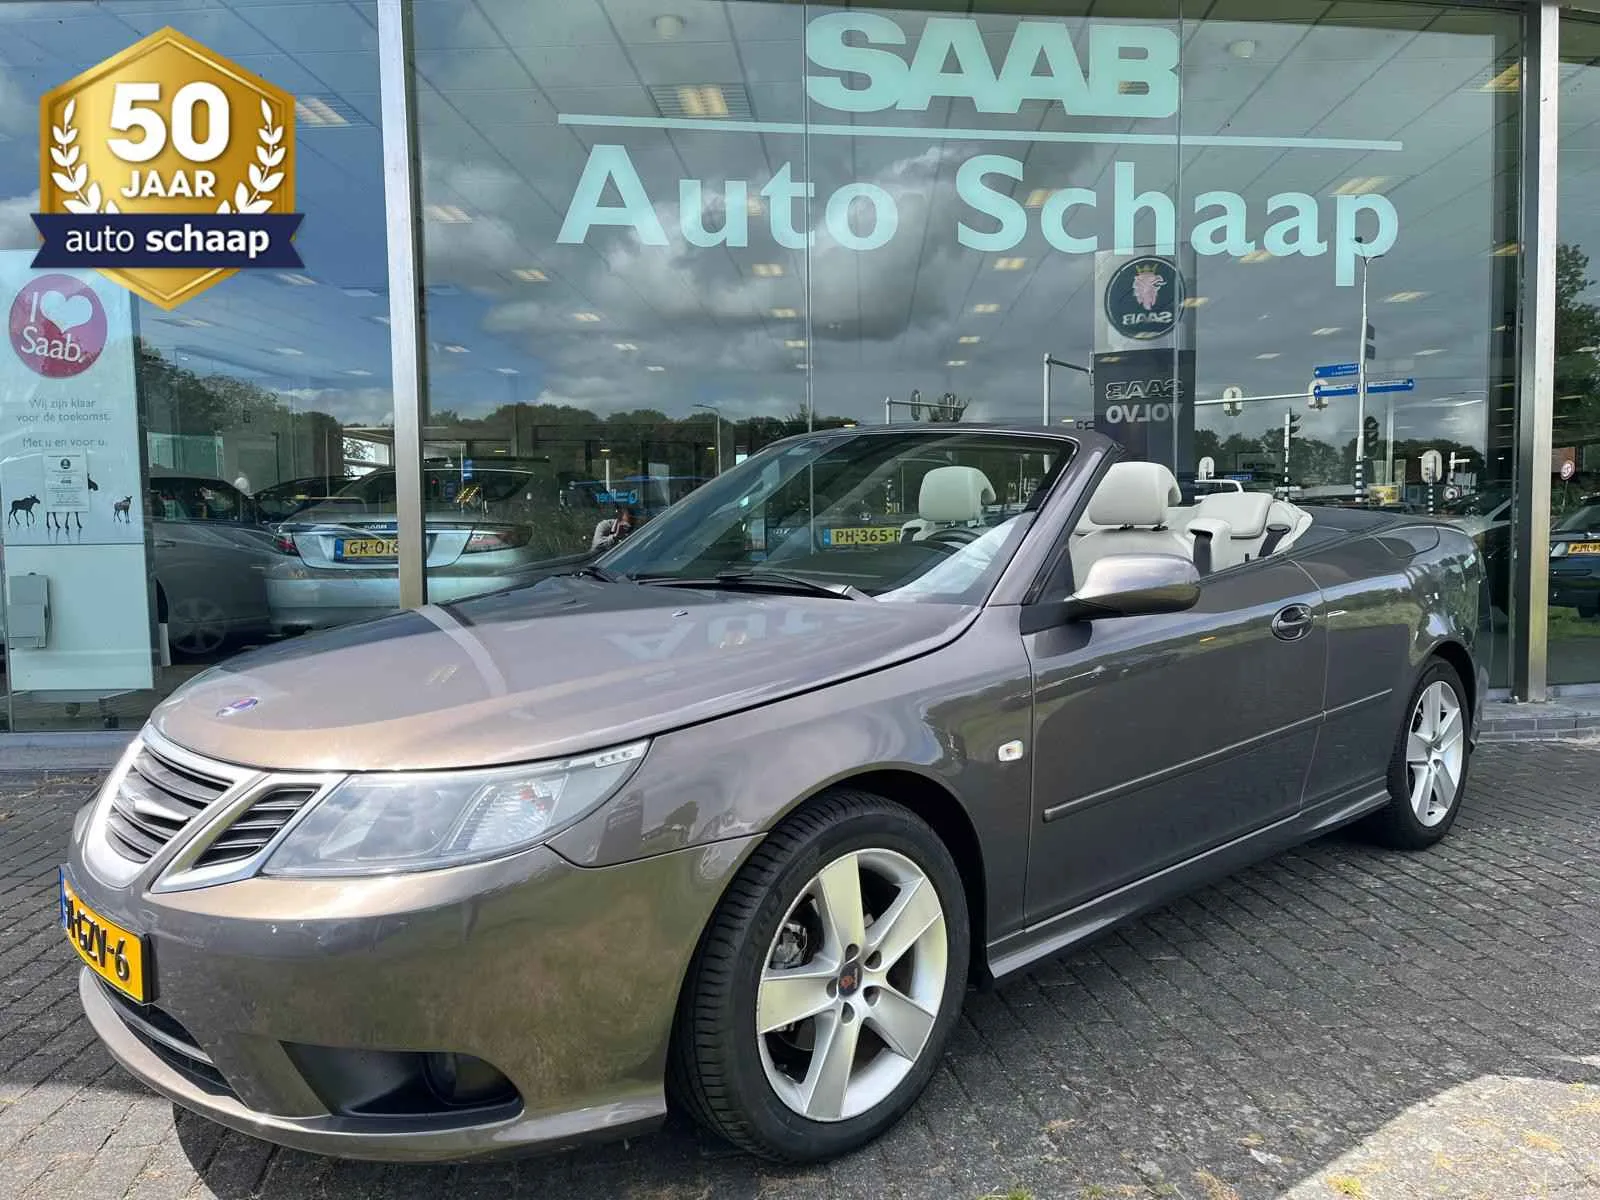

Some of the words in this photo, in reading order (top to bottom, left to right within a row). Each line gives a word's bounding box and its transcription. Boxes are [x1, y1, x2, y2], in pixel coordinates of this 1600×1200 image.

[802, 12, 1179, 118] SAAB
[556, 144, 899, 251] Auto
[955, 154, 1398, 287] Schaap
[29, 399, 46, 410] Wij
[51, 400, 68, 410] zijn
[71, 398, 96, 408] klaar
[16, 414, 39, 422] voor
[44, 412, 55, 421] de
[70, 439, 94, 447] voor
